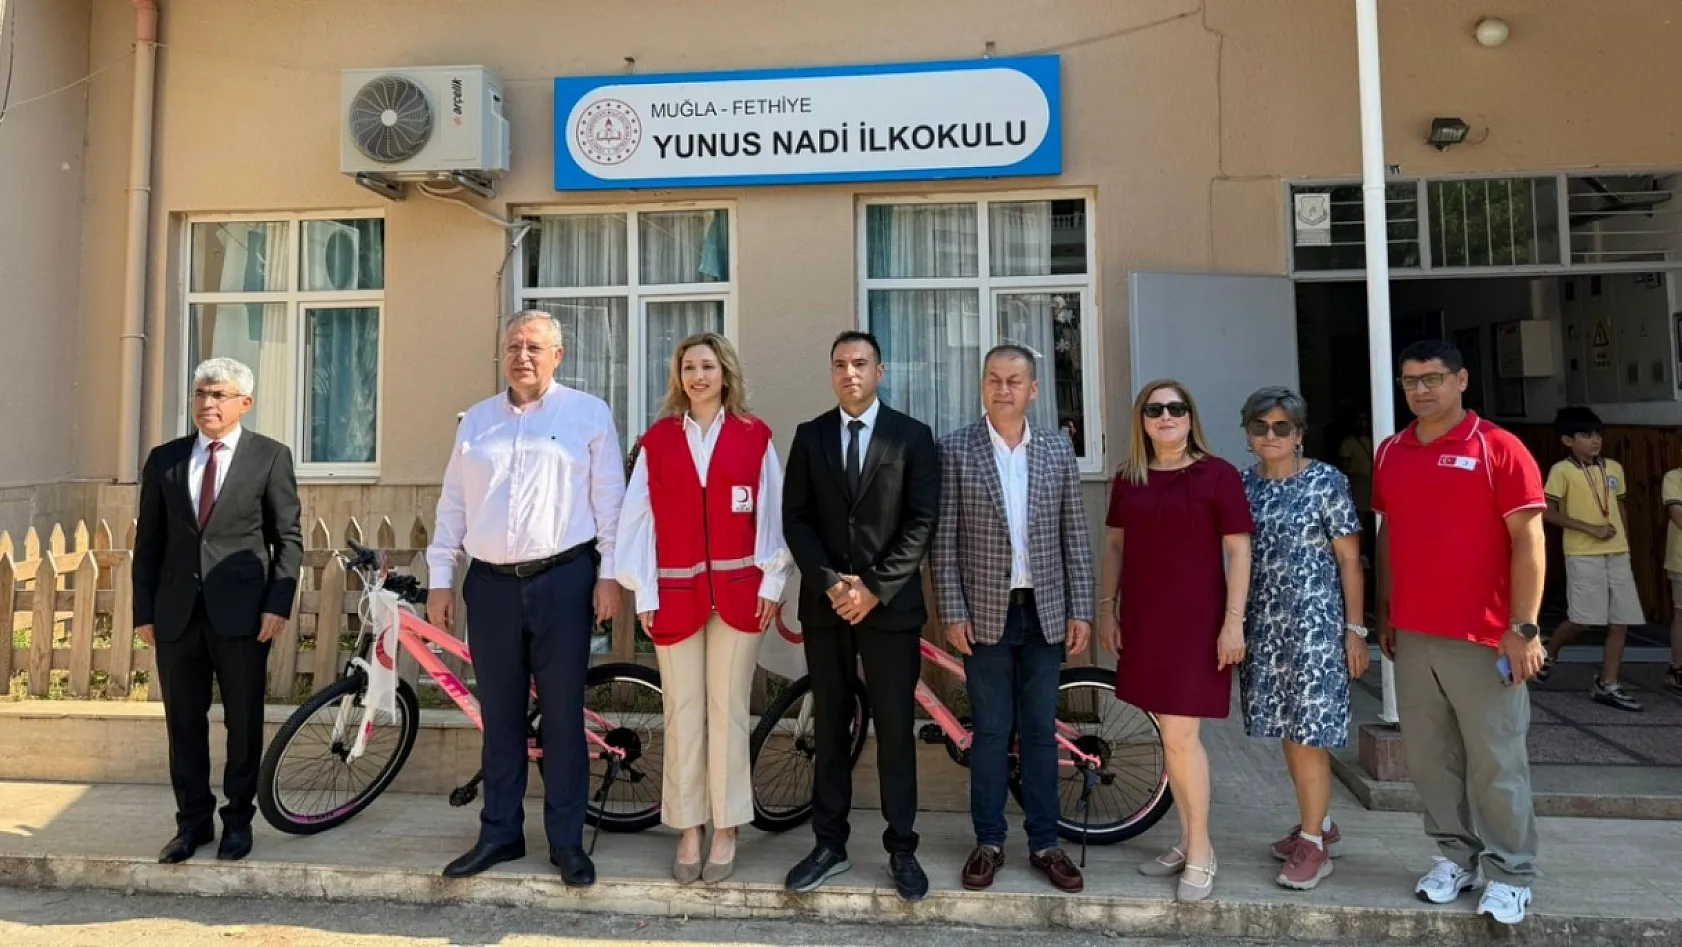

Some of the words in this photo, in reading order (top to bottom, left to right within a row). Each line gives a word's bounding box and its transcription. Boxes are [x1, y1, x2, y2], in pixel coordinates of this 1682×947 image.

[451, 77, 465, 115] arçelik
[651, 98, 717, 118] MUĞLA
[733, 95, 812, 116] FETHİYE
[653, 132, 762, 159] YUNUS
[773, 122, 849, 155] NADİ
[859, 120, 1027, 153] İLKOKULU
